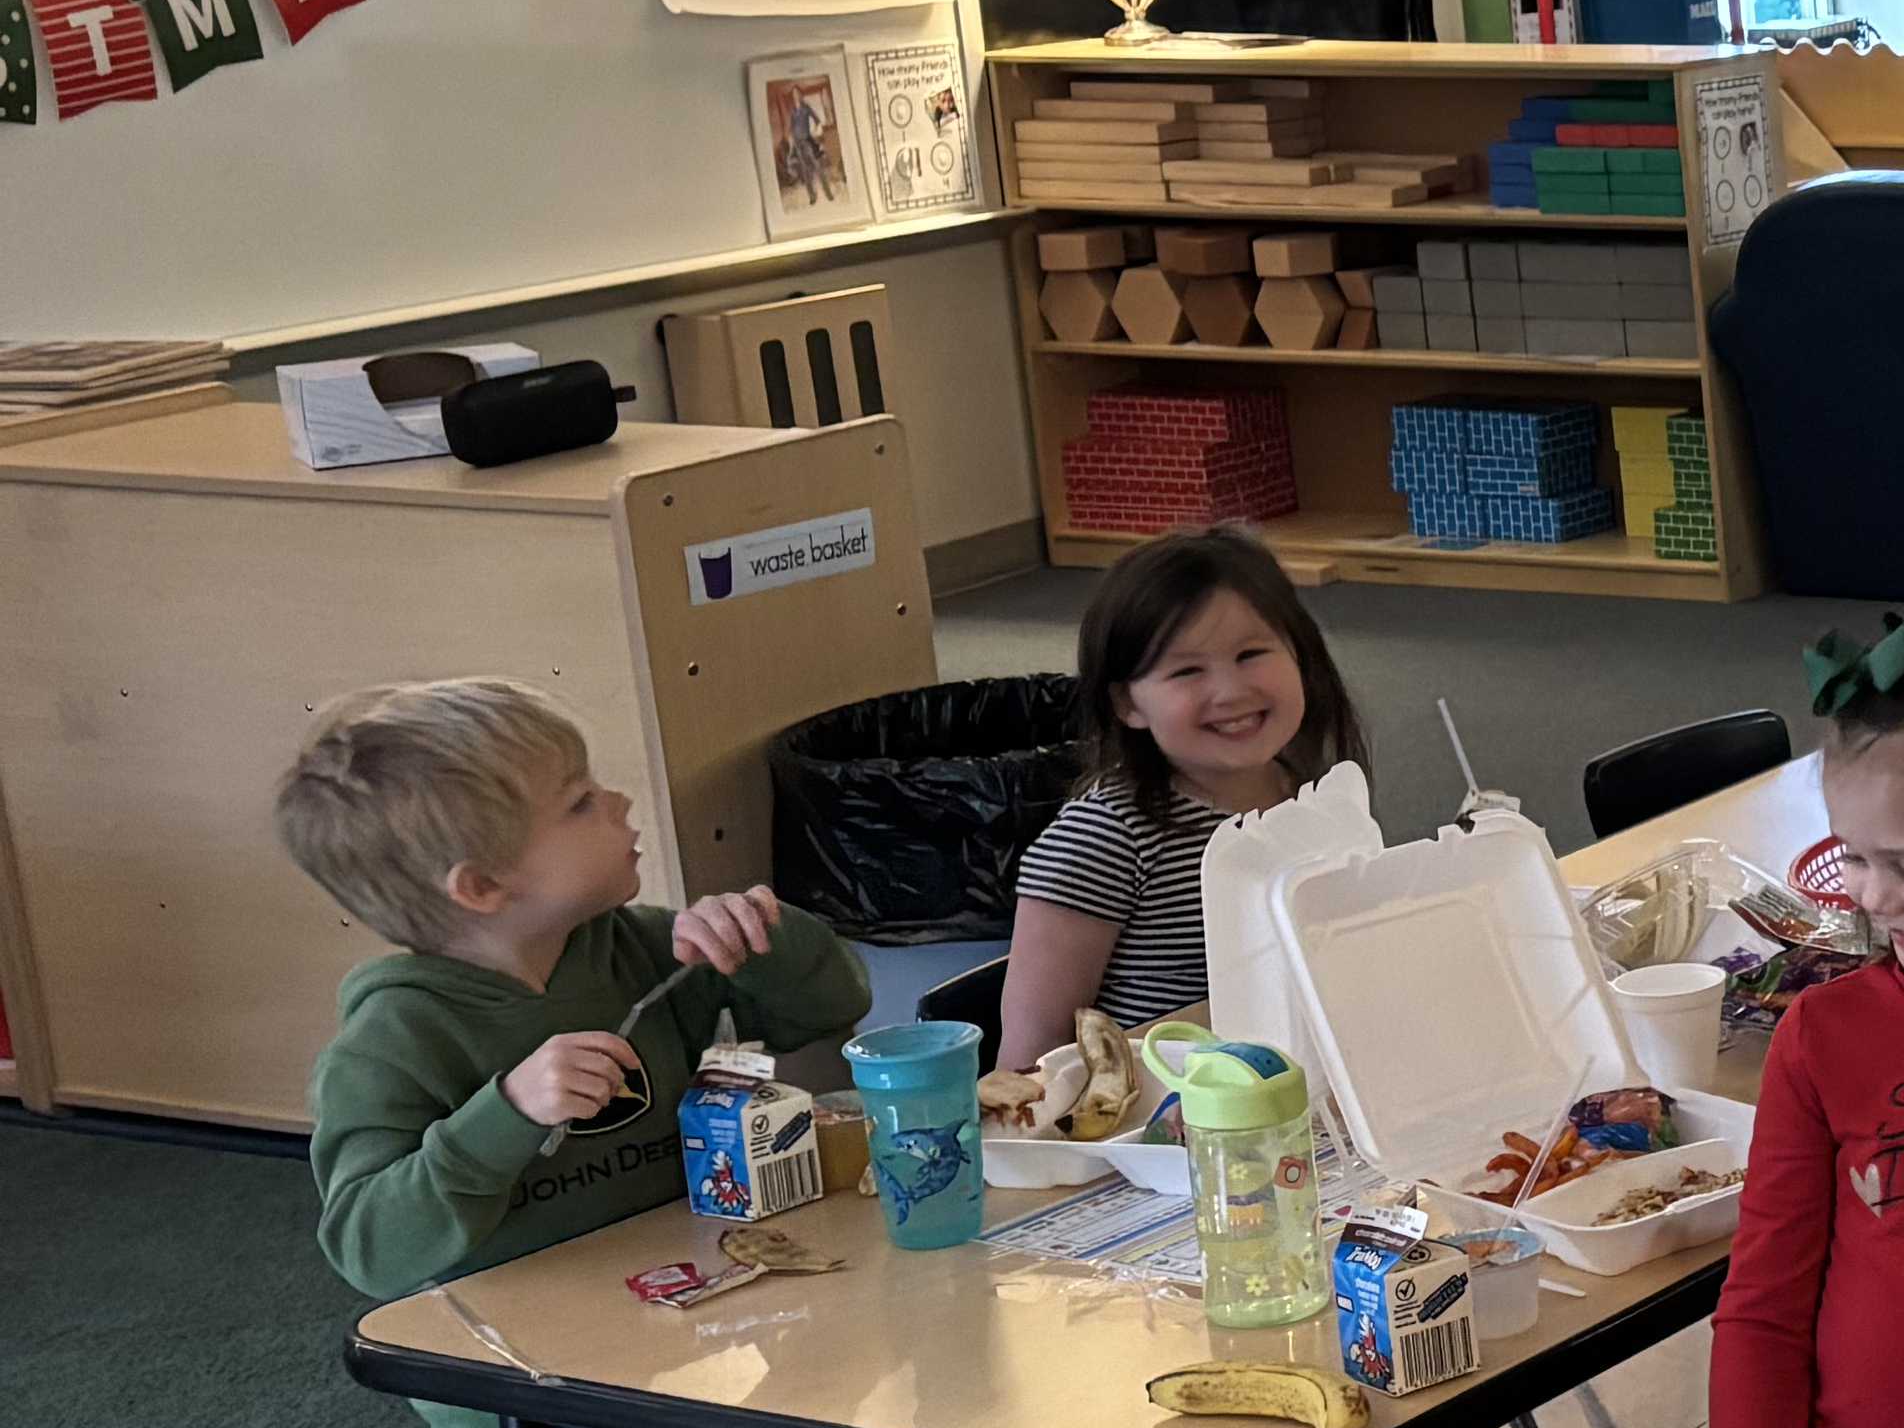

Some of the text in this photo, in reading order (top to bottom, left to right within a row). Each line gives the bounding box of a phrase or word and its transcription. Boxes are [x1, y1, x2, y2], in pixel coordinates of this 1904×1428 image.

[750, 526, 868, 578] waste basket
[510, 1134, 682, 1210] JOHN DEE
